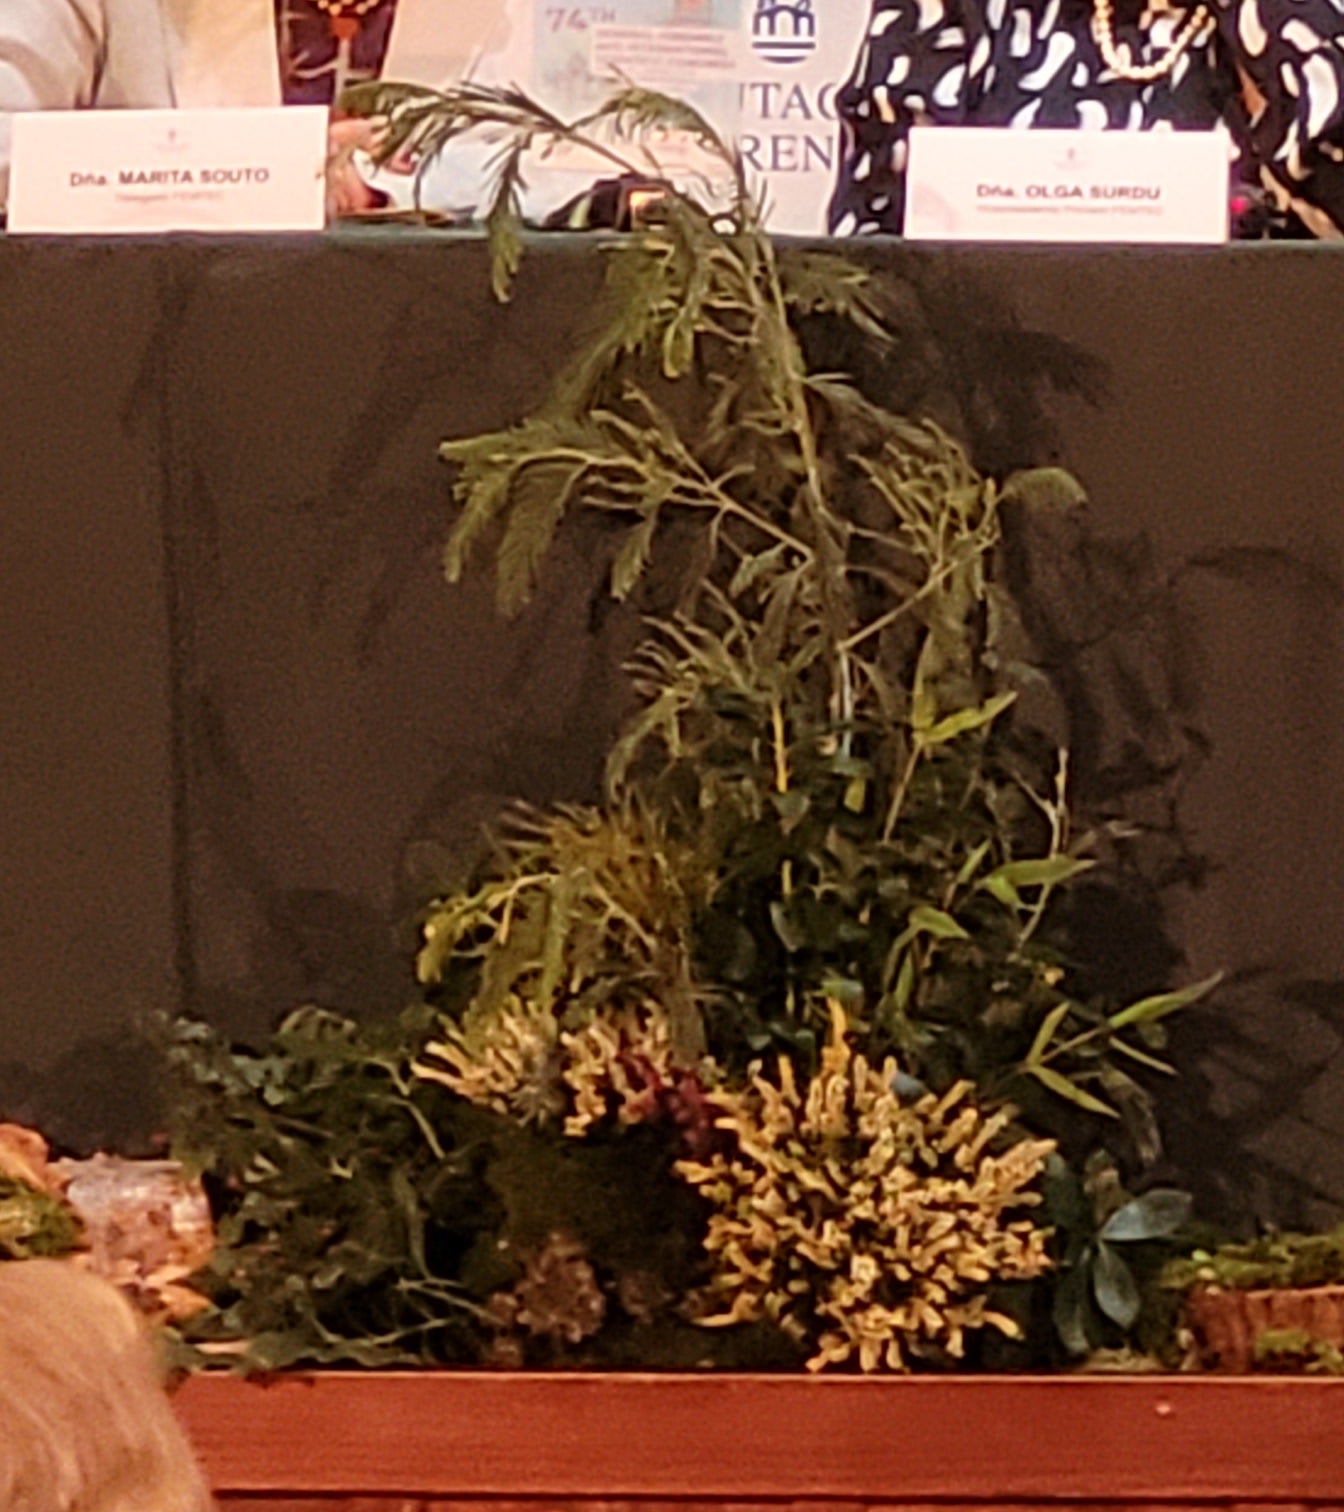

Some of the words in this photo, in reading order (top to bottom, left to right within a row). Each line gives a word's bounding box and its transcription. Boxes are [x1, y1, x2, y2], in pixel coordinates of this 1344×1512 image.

[118, 170, 193, 185] MARITA
[199, 168, 270, 184] SOUTO
[1025, 185, 1083, 199] OLGA
[1090, 186, 1161, 200] SURDU
